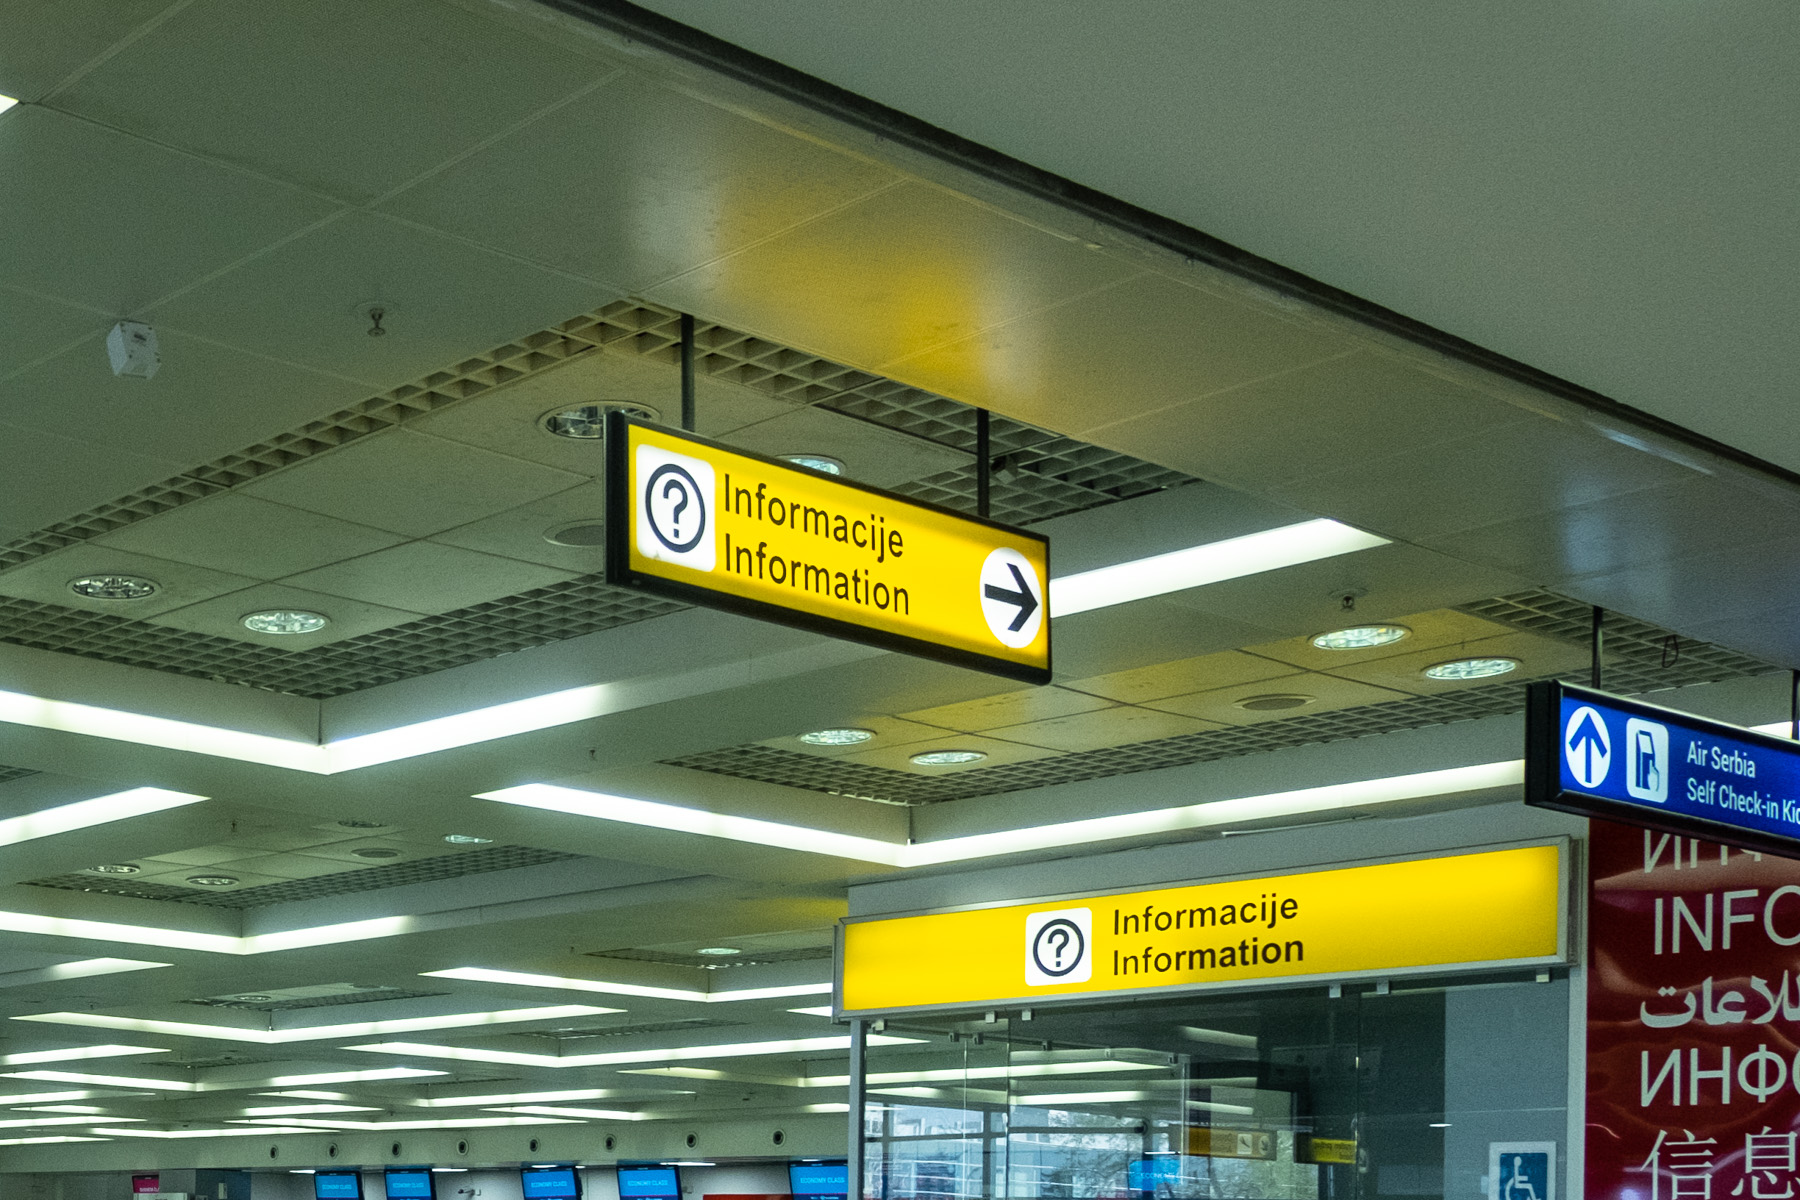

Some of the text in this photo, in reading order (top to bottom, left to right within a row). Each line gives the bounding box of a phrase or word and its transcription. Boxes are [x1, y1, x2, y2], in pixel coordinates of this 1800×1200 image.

[724, 473, 904, 563] Informacije
[725, 533, 910, 616] Information
[1687, 740, 1756, 779] Air Serbia
[1687, 777, 1716, 806] Self
[1719, 784, 1780, 820] Check-in
[1113, 893, 1299, 936] Informacije
[1113, 937, 1304, 977] Information
[1640, 1043, 1800, 1107] ИНФ
[827, 1176, 845, 1184] CLASS
